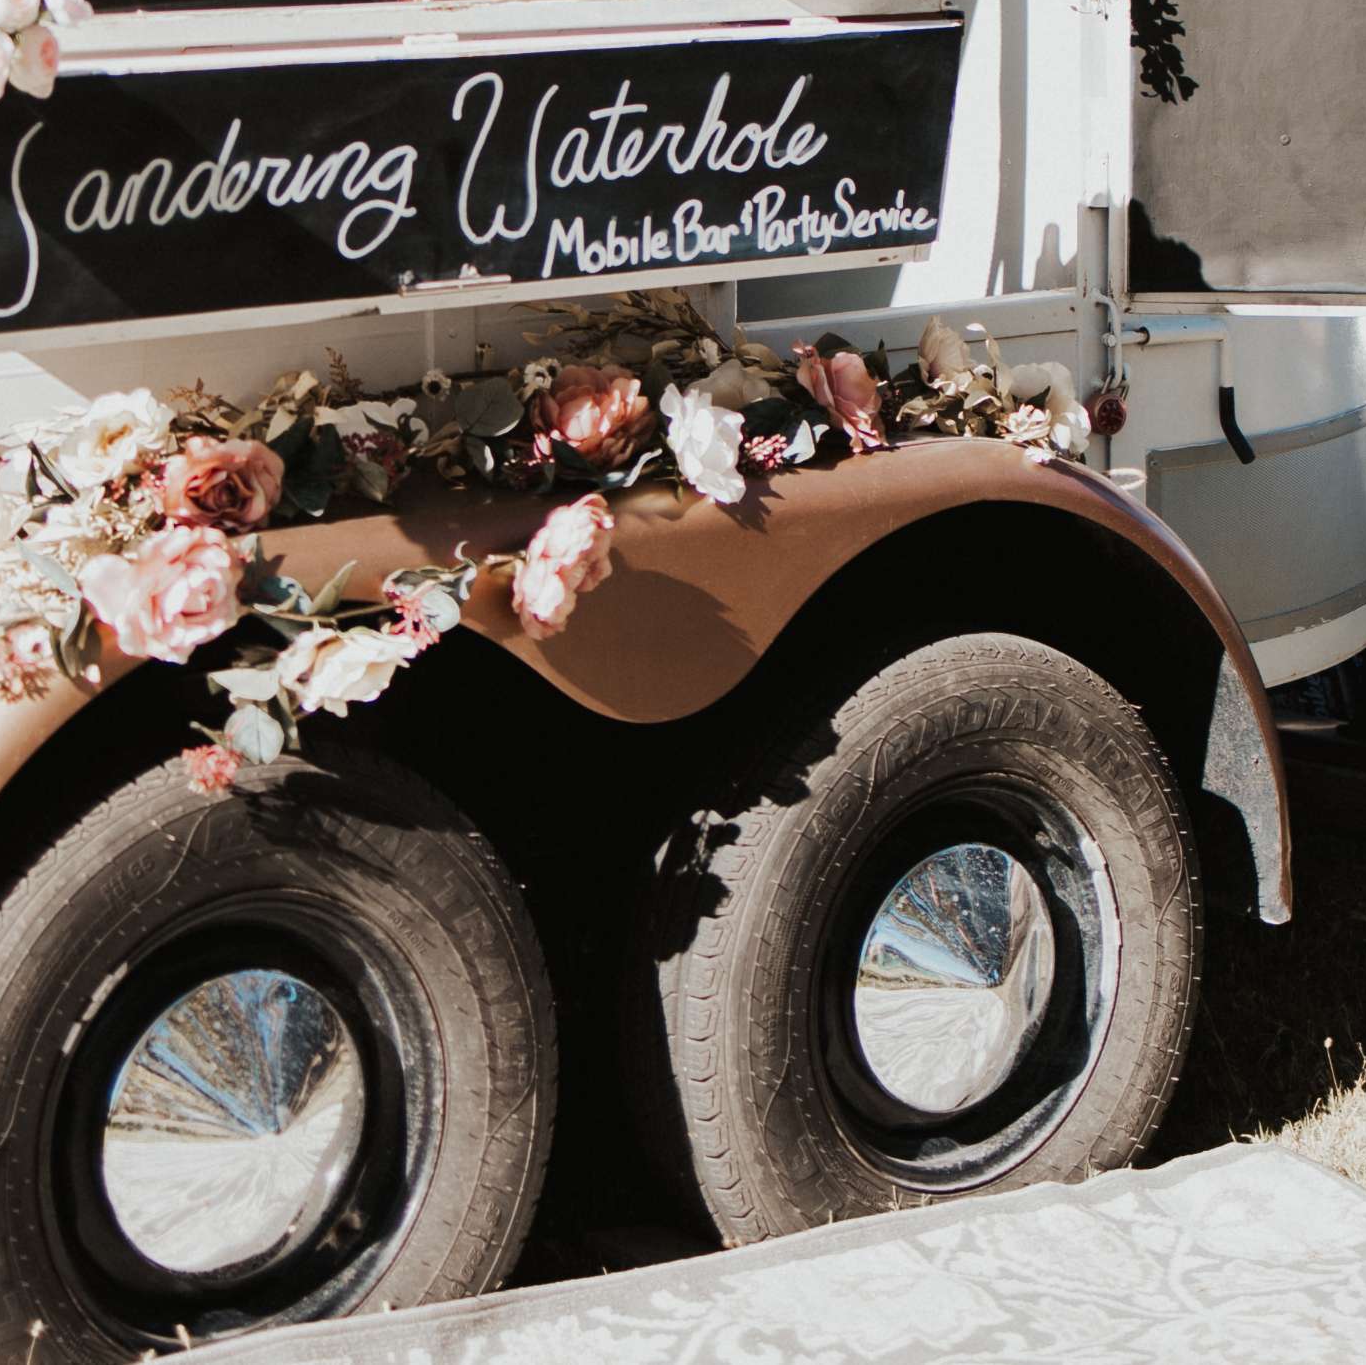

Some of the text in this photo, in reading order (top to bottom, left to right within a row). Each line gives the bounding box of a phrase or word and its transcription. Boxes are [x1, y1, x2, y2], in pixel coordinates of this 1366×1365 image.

[451, 71, 828, 245] Waterhole
[541, 215, 673, 279] Mobile
[672, 198, 737, 262] Bar
[751, 184, 836, 255] Party
[833, 177, 938, 238] Service
